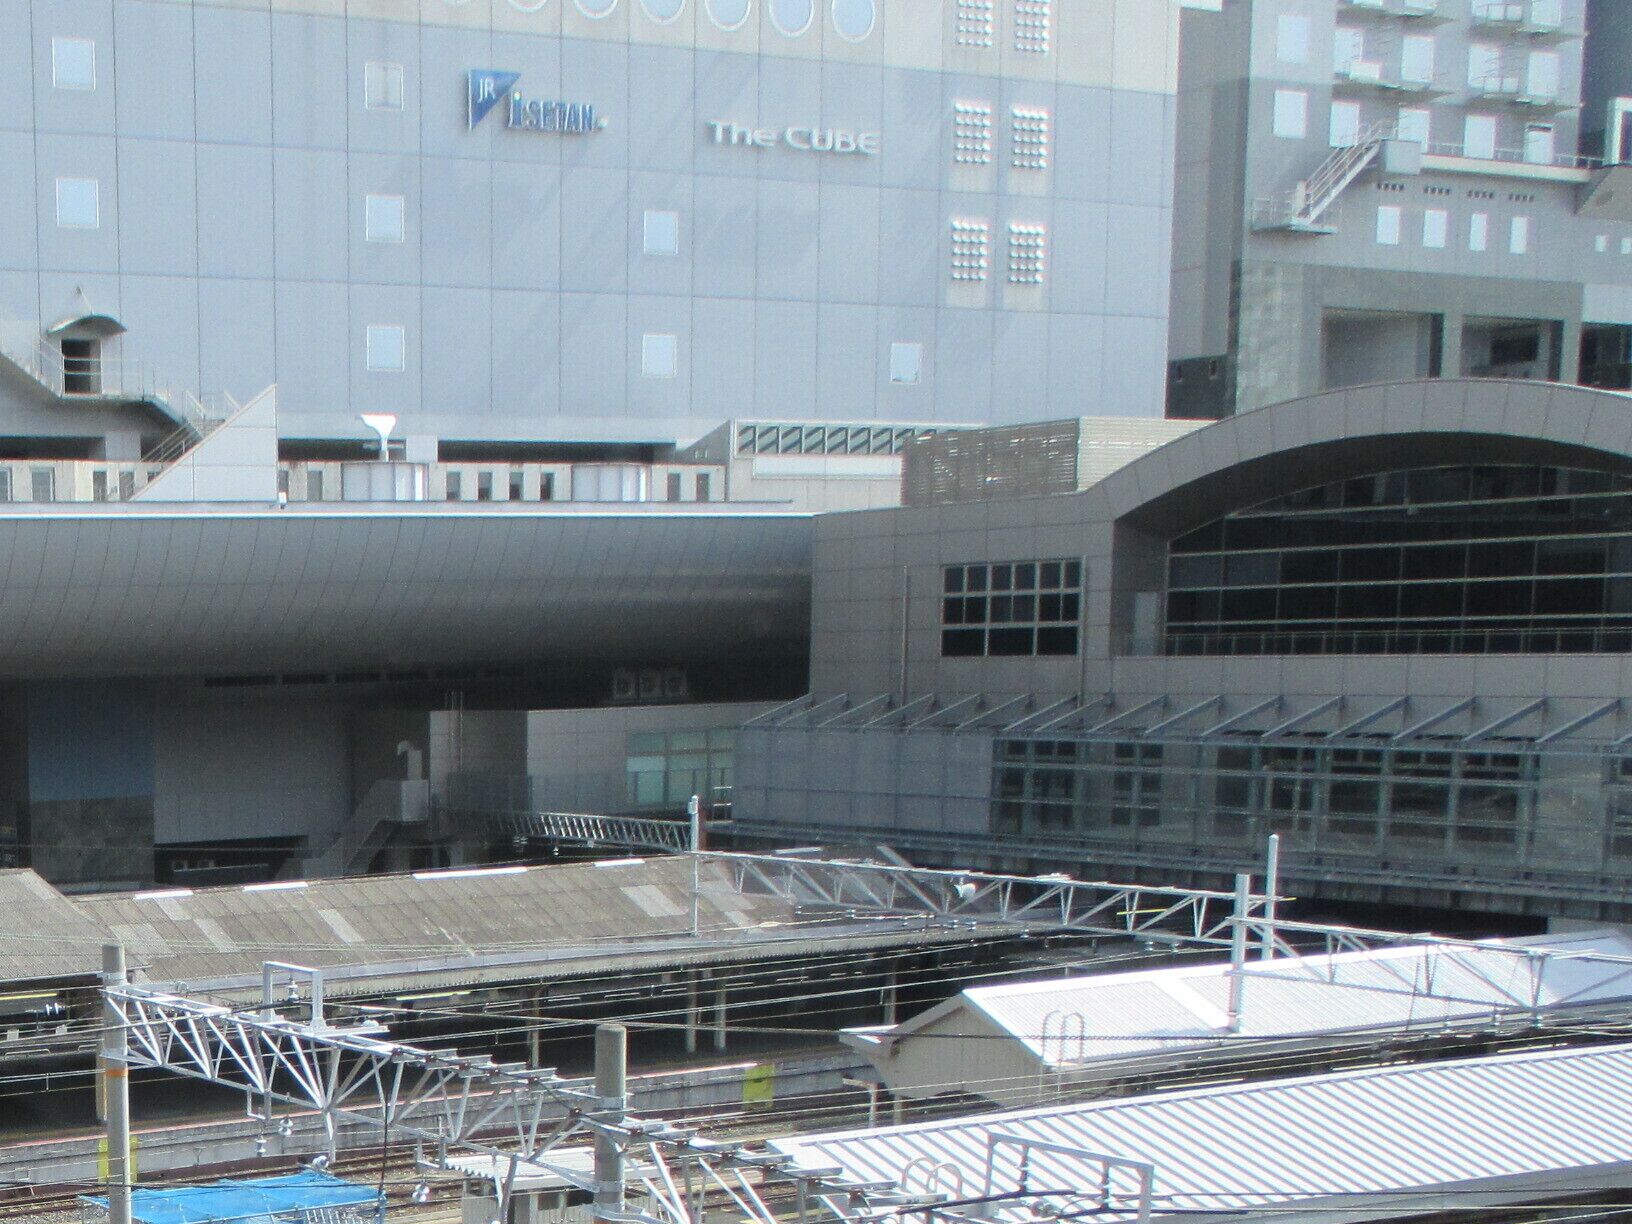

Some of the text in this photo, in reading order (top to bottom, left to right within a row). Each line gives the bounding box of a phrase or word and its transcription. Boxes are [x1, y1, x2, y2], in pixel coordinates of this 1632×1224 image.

[478, 77, 496, 104] JR
[705, 119, 881, 156] The CUBE
